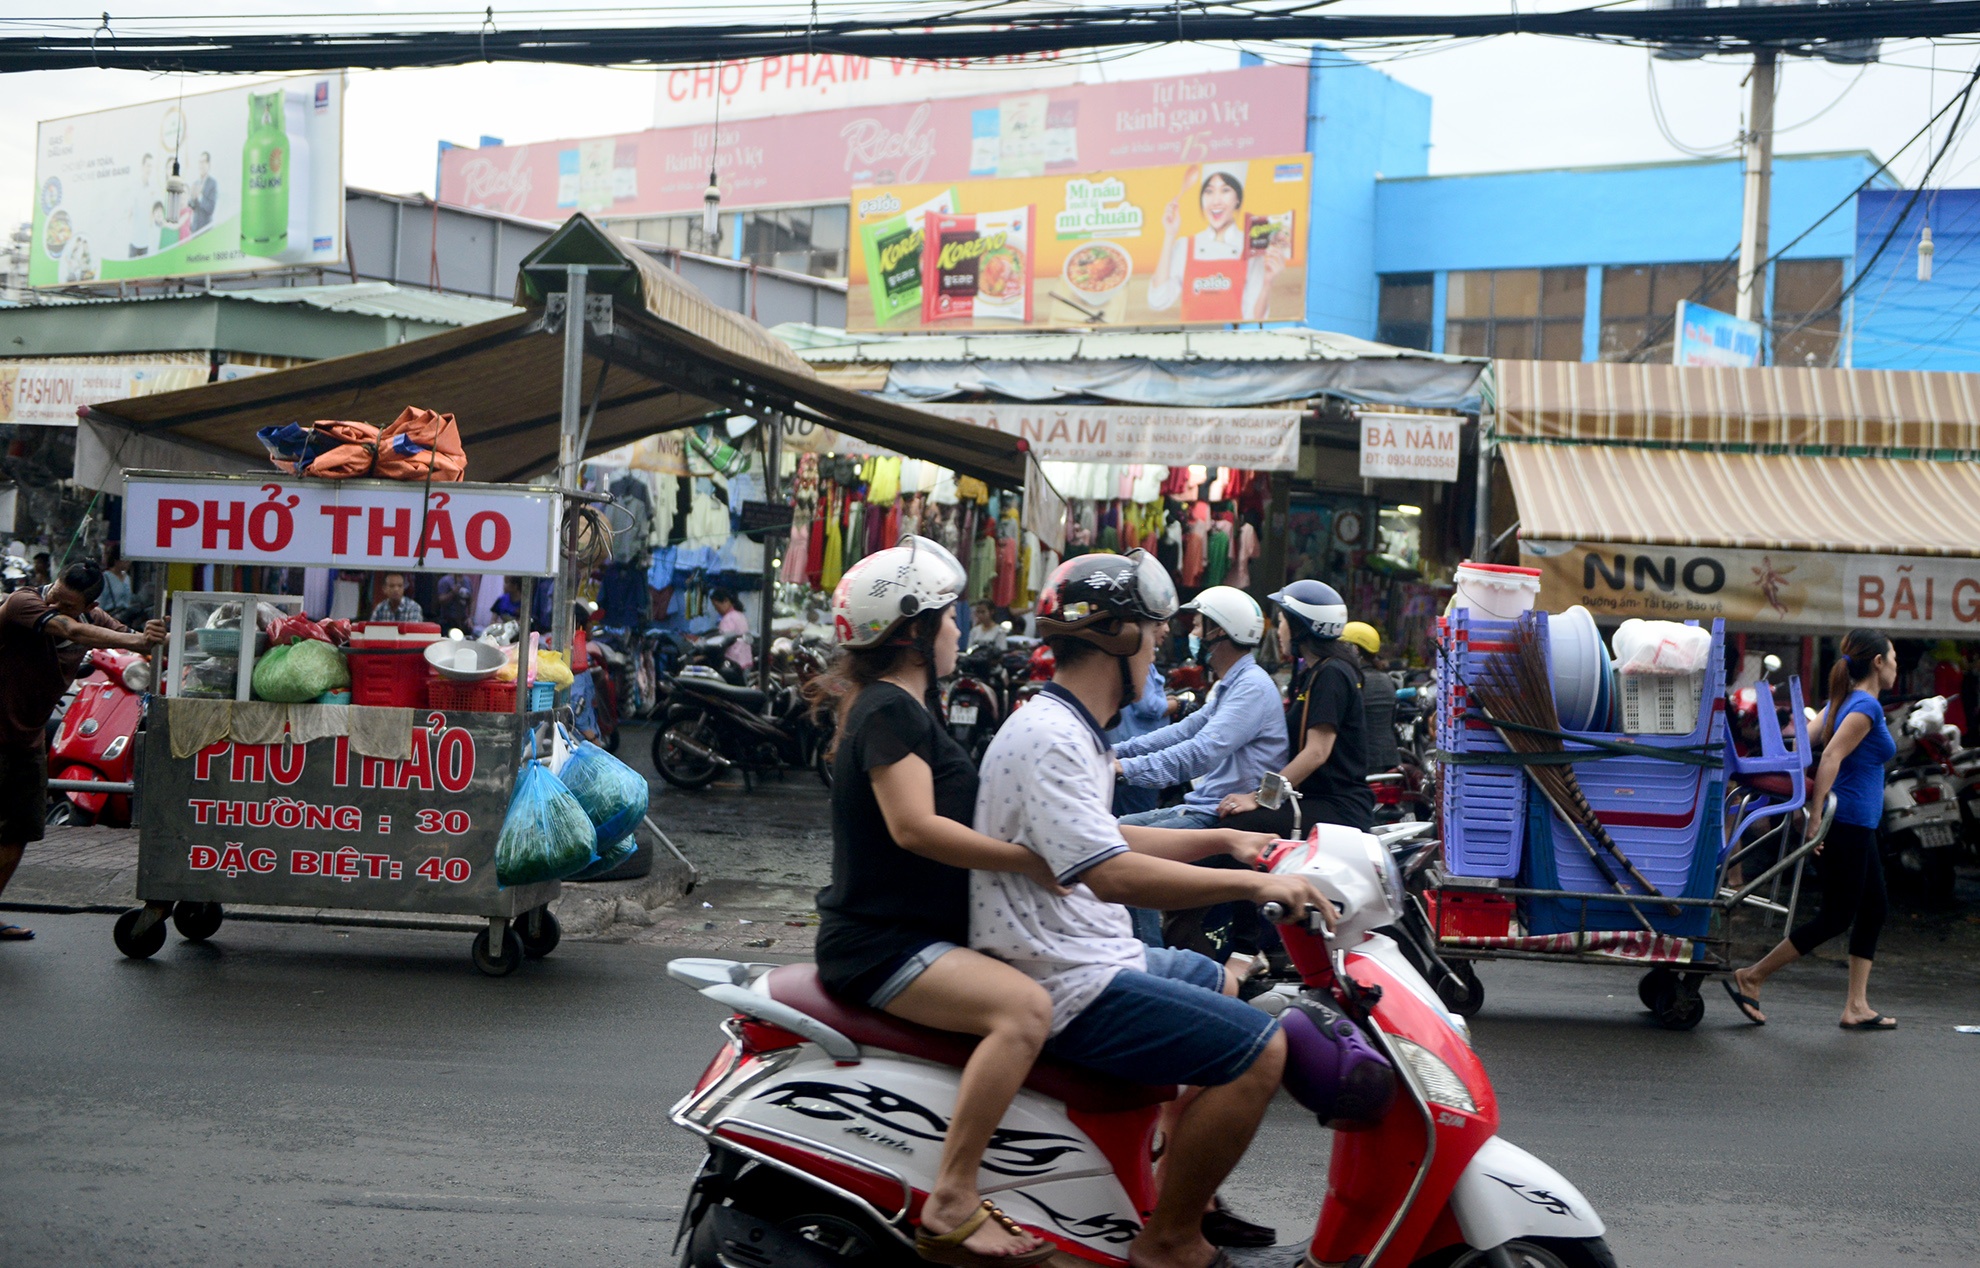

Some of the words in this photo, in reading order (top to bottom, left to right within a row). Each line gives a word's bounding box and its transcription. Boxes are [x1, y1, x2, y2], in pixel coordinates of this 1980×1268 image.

[668, 57, 749, 105] CHỢ
[1179, 78, 1216, 103] hào
[1116, 107, 1166, 132] Bánh
[1169, 107, 1207, 134] gạo
[1211, 100, 1249, 128] Việt
[937, 231, 1008, 271] KORENO
[19, 378, 74, 405] FASHION
[1020, 411, 1107, 444] NĂM
[1366, 422, 1397, 448] BÀ
[1405, 424, 1454, 451] NĂM
[156, 483, 301, 553] PHỞ
[320, 491, 512, 562] THẢO
[1583, 552, 1726, 595] NNO
[1857, 564, 1934, 621] BÃI
[188, 796, 362, 832] THƯỜNG
[378, 814, 392, 835] :
[414, 808, 471, 836] 30
[188, 841, 278, 879] ĐẶC
[290, 845, 403, 882] BIỆT:
[415, 856, 472, 883] 40
[1436, 1111, 1467, 1129] SYM
